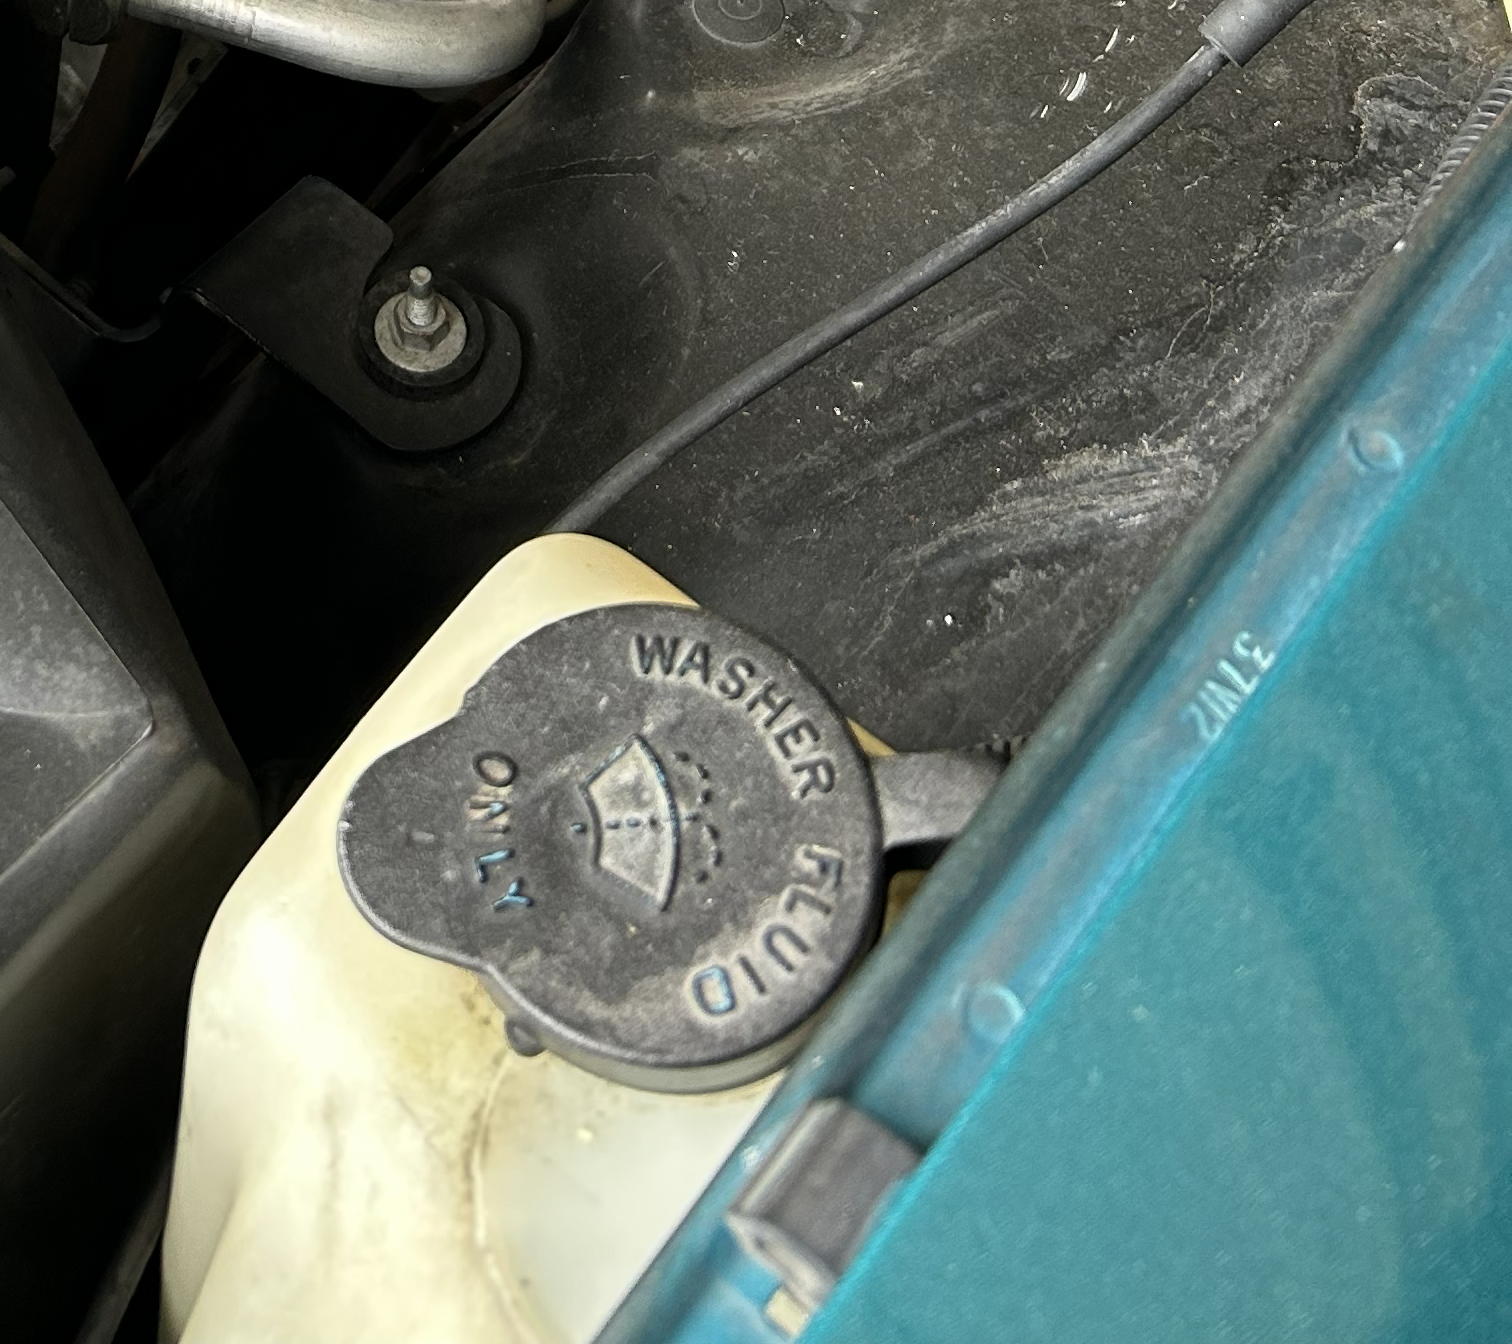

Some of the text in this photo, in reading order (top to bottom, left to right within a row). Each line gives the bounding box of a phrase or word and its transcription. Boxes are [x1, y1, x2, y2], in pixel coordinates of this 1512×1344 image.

[468, 750, 535, 912] ONLY
[635, 632, 844, 1015] WASHER FLUID
